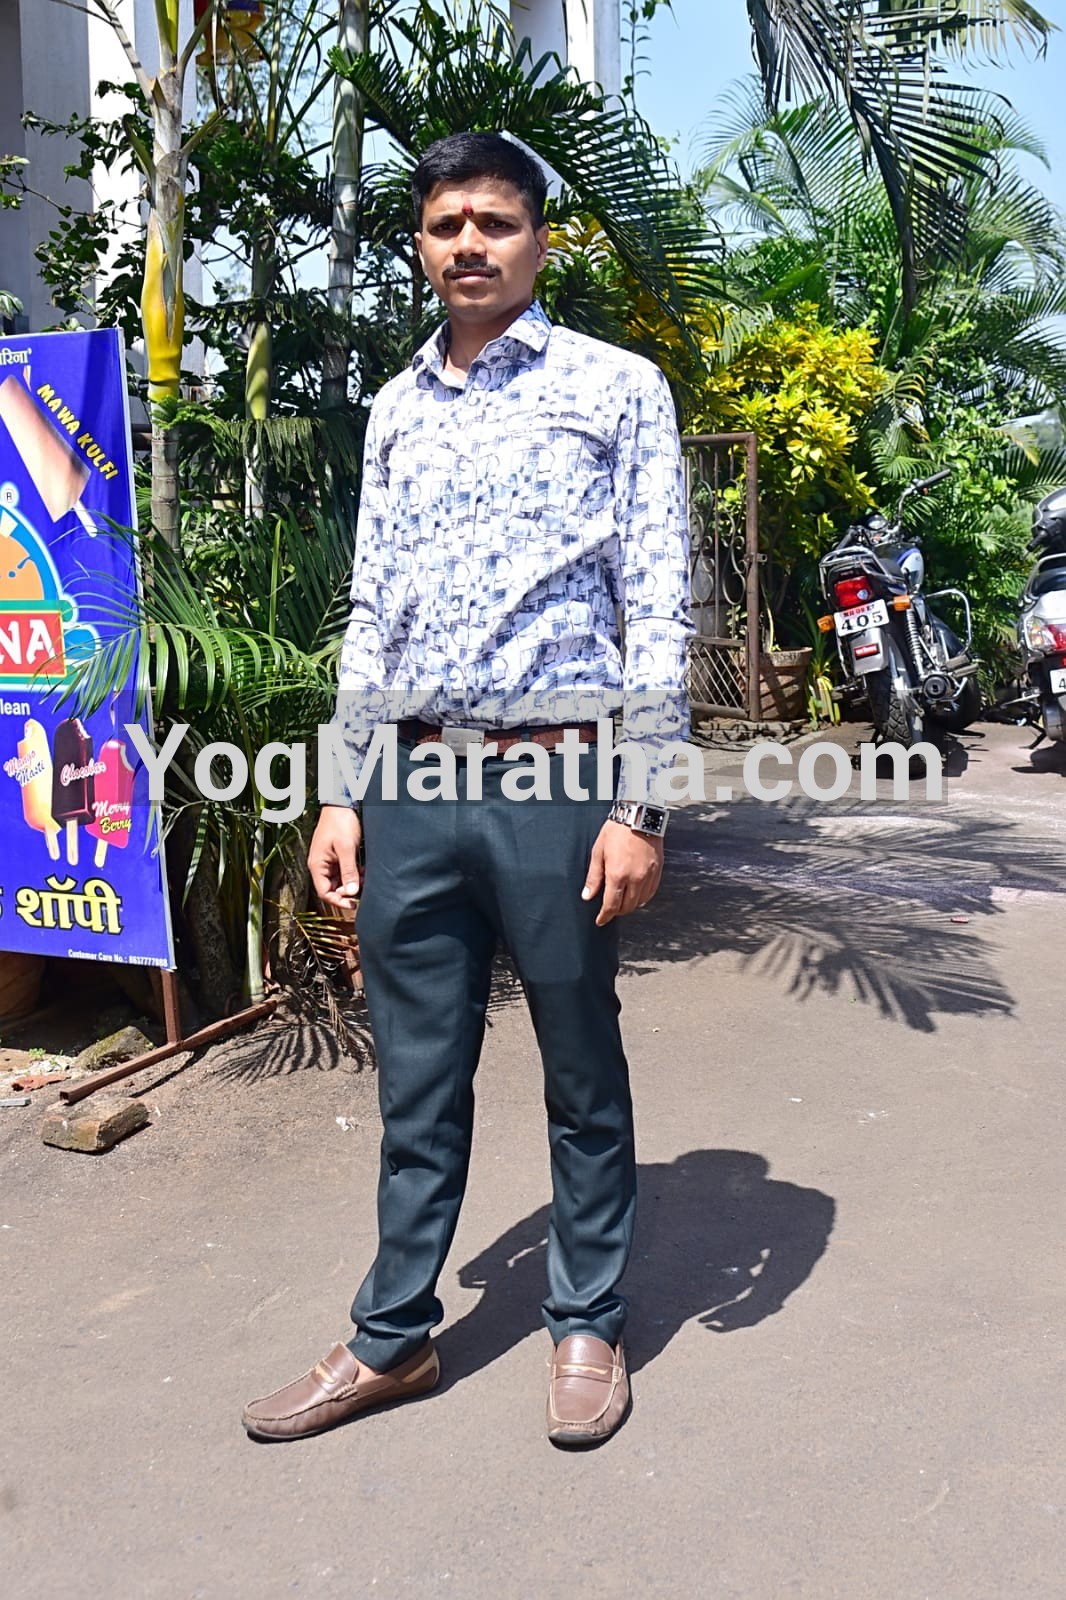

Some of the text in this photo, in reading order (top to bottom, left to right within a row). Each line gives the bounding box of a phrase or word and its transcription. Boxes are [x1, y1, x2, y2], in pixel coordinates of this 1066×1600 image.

[36, 383, 119, 480] MAWA KULFI
[841, 611, 883, 631] 405
[60, 758, 107, 786] Chocobar
[100, 816, 132, 834] Berry
[15, 873, 123, 935] शॉपी
[67, 948, 97, 960] Customer
[98, 952, 112, 963] Care
